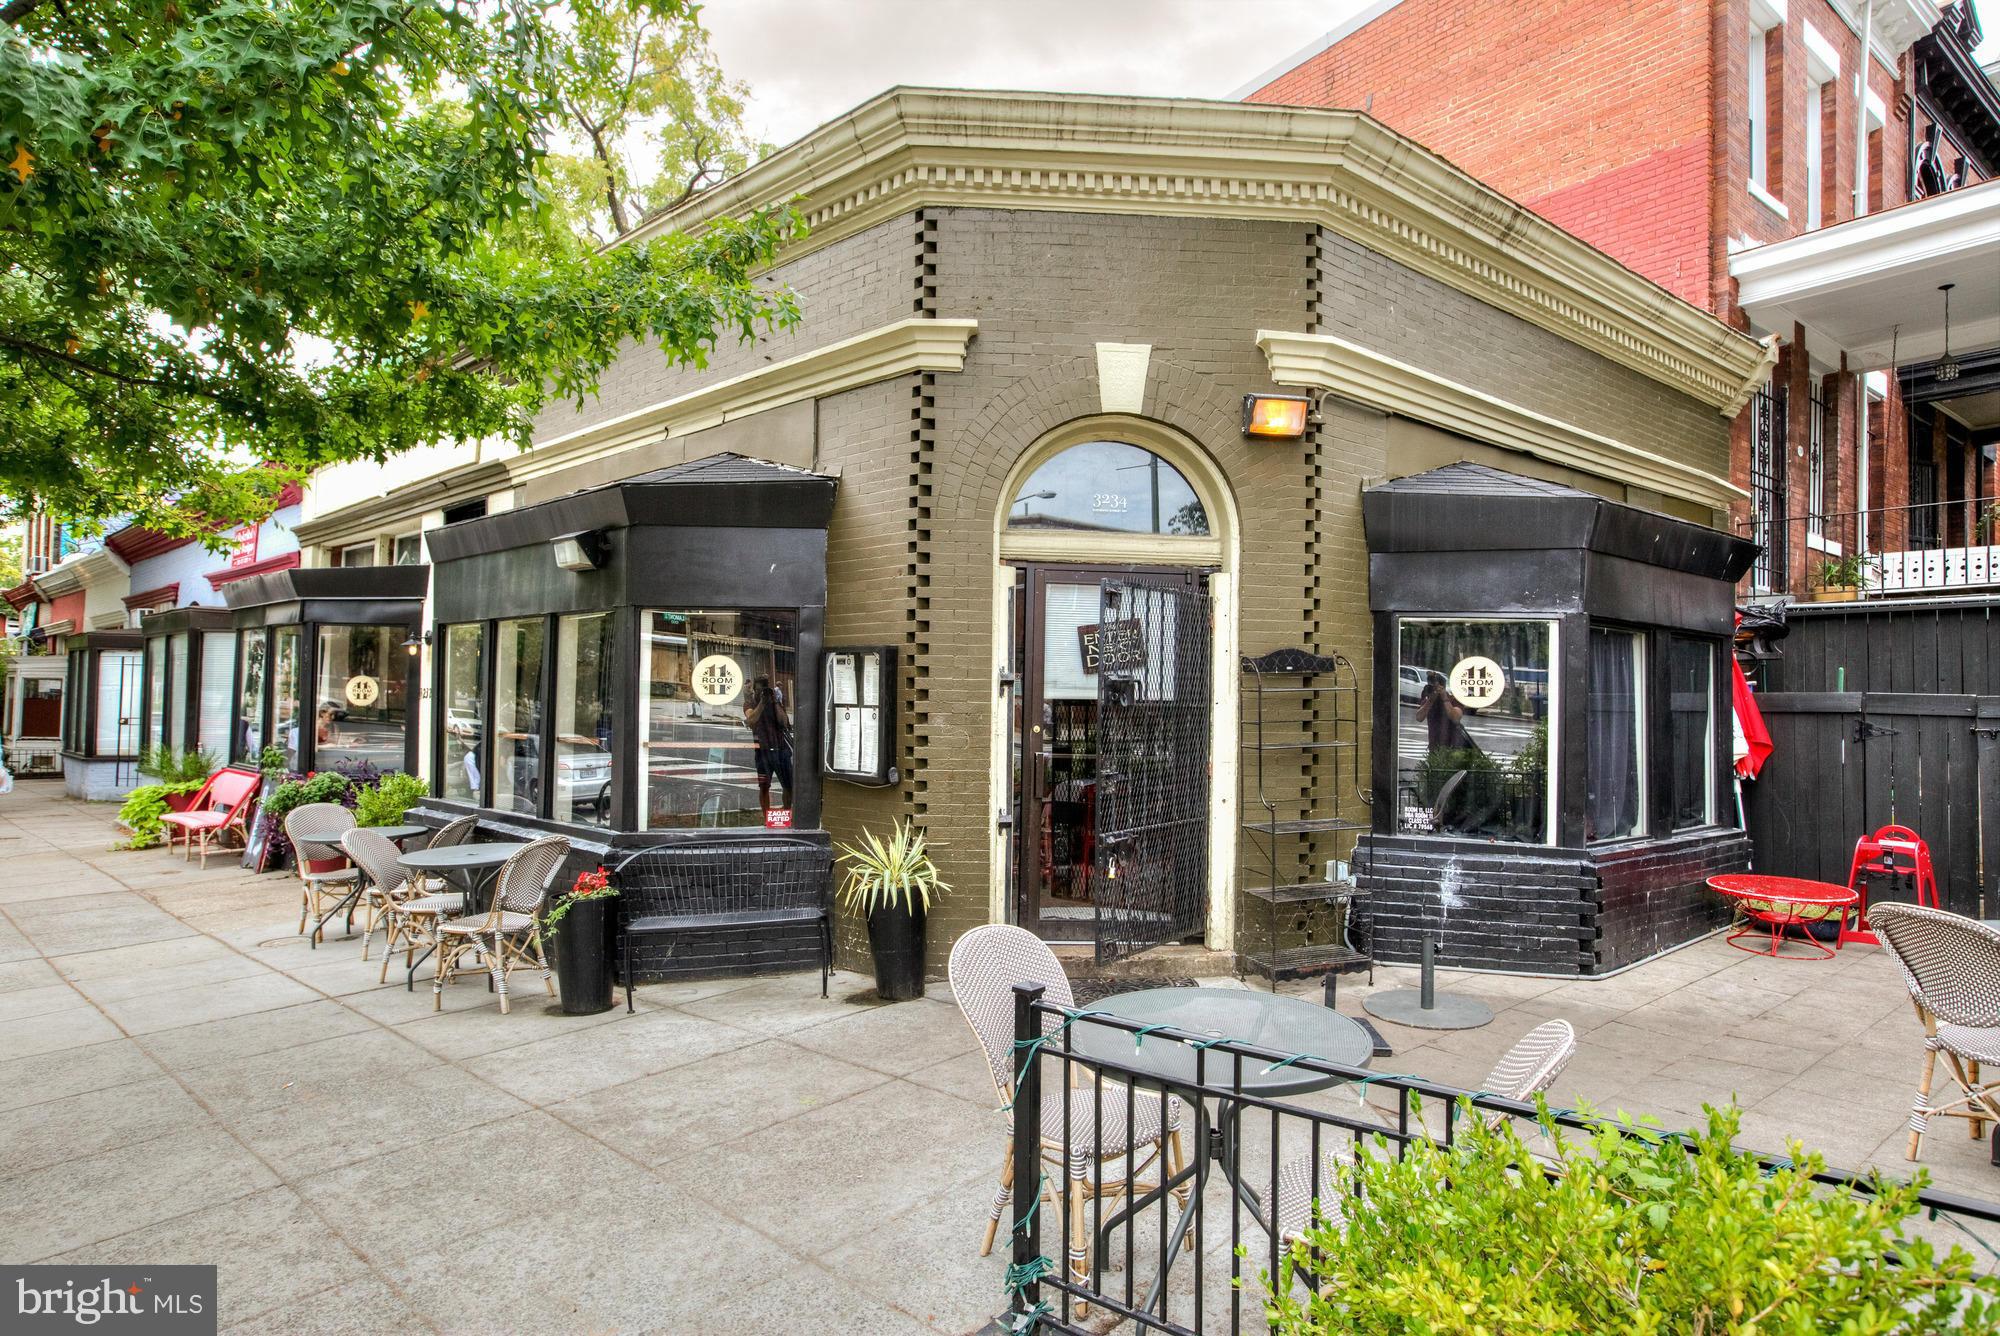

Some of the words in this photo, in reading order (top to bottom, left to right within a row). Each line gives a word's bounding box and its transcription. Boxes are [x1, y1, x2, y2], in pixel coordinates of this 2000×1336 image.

[1093, 494, 1127, 508] 3234
[705, 664, 730, 695] 11
[1464, 665, 1490, 698] 11
